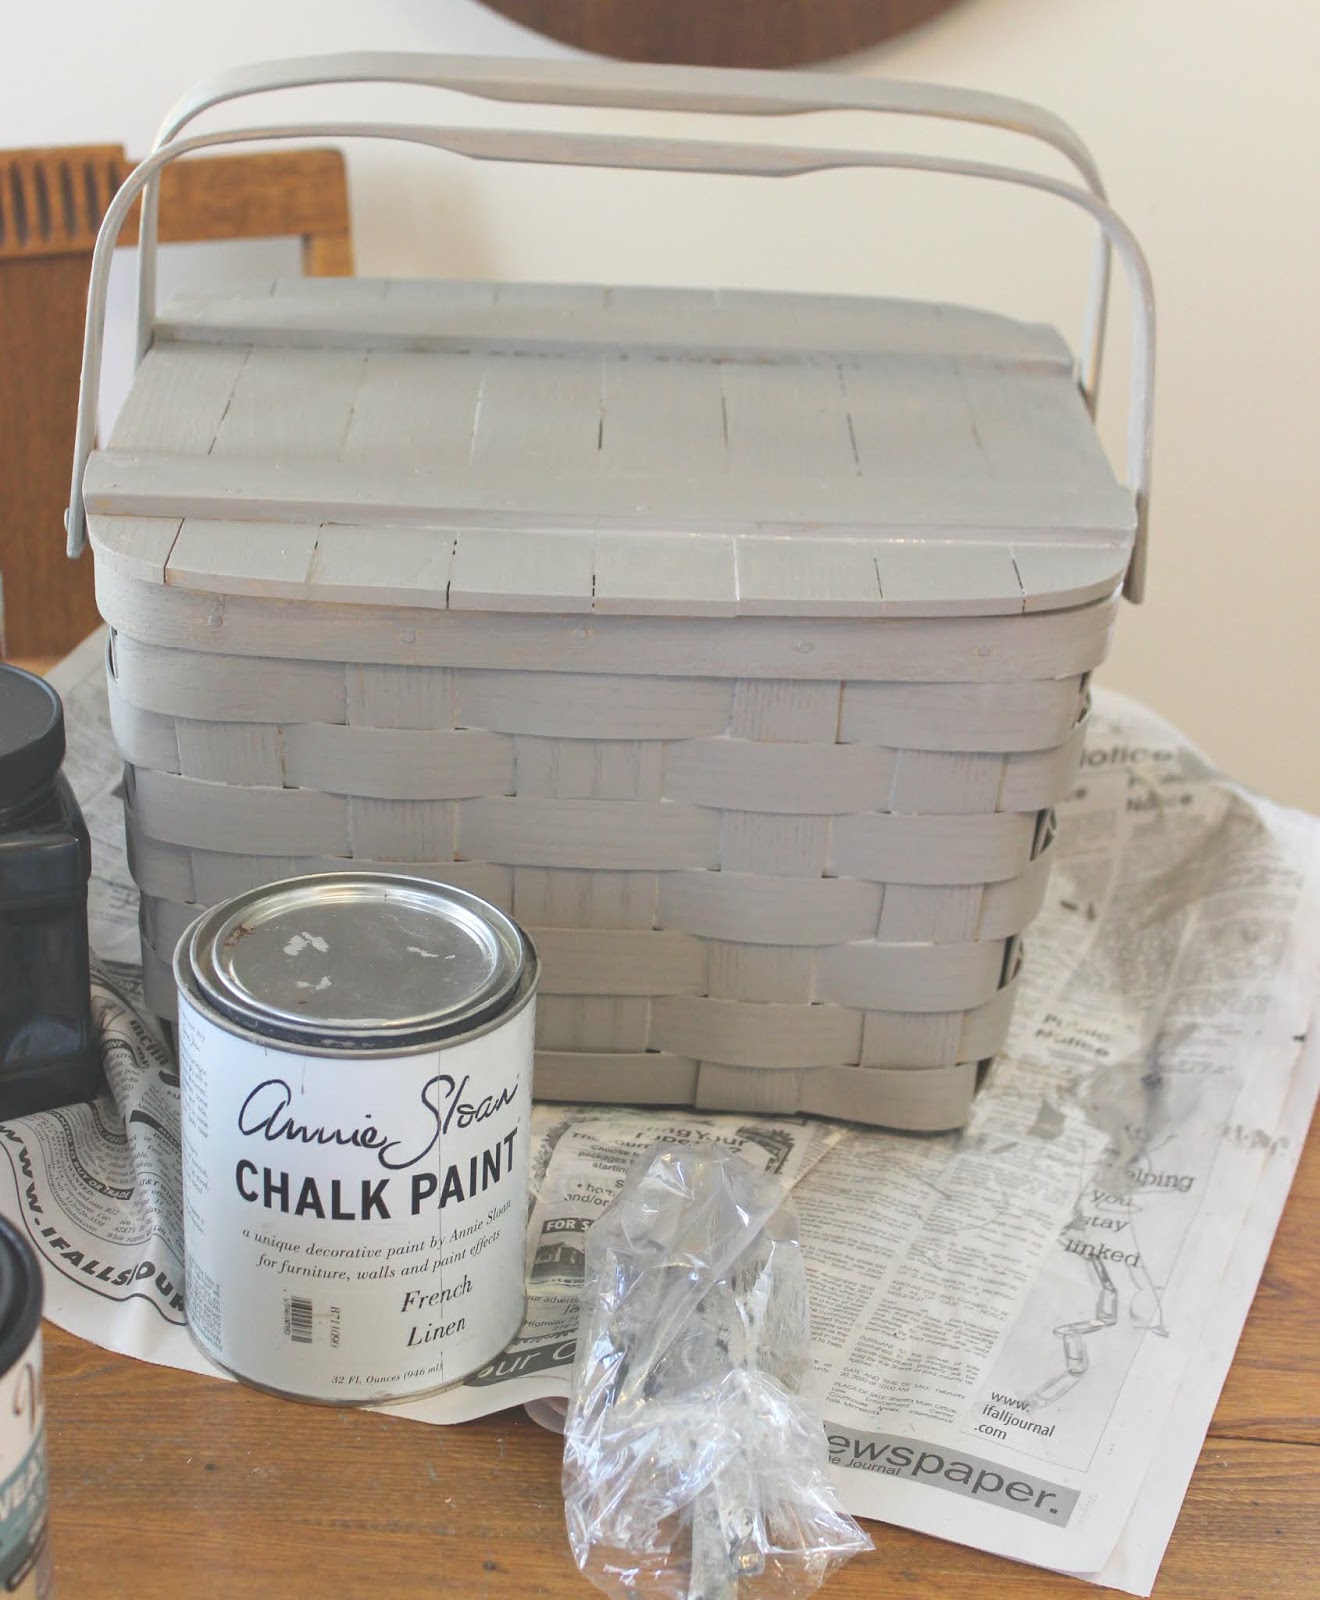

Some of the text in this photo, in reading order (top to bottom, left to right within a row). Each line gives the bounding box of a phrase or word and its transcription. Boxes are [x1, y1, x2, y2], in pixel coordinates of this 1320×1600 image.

[238, 1078, 388, 1149] Annie
[378, 1074, 519, 1170] Sloan
[235, 1159, 391, 1220] CHALK
[411, 1127, 518, 1216] PAINT
[242, 1199, 512, 1260] a unique decorative paint by Annie Sloan
[545, 1219, 577, 1232] FOR
[256, 1229, 501, 1281] for furniture, walls and paint effects
[1063, 1238, 1141, 1269] linked
[400, 1274, 474, 1313] French
[406, 1317, 466, 1348] Linen
[331, 1375, 345, 1384] 32
[365, 1374, 400, 1384] Ounces
[990, 1391, 1030, 1413] www.
[974, 1423, 1008, 1441] .com
[982, 1403, 1056, 1438] ifalljournal
[824, 1430, 1058, 1515] ewspaper.
[844, 1457, 902, 1476] Journal
